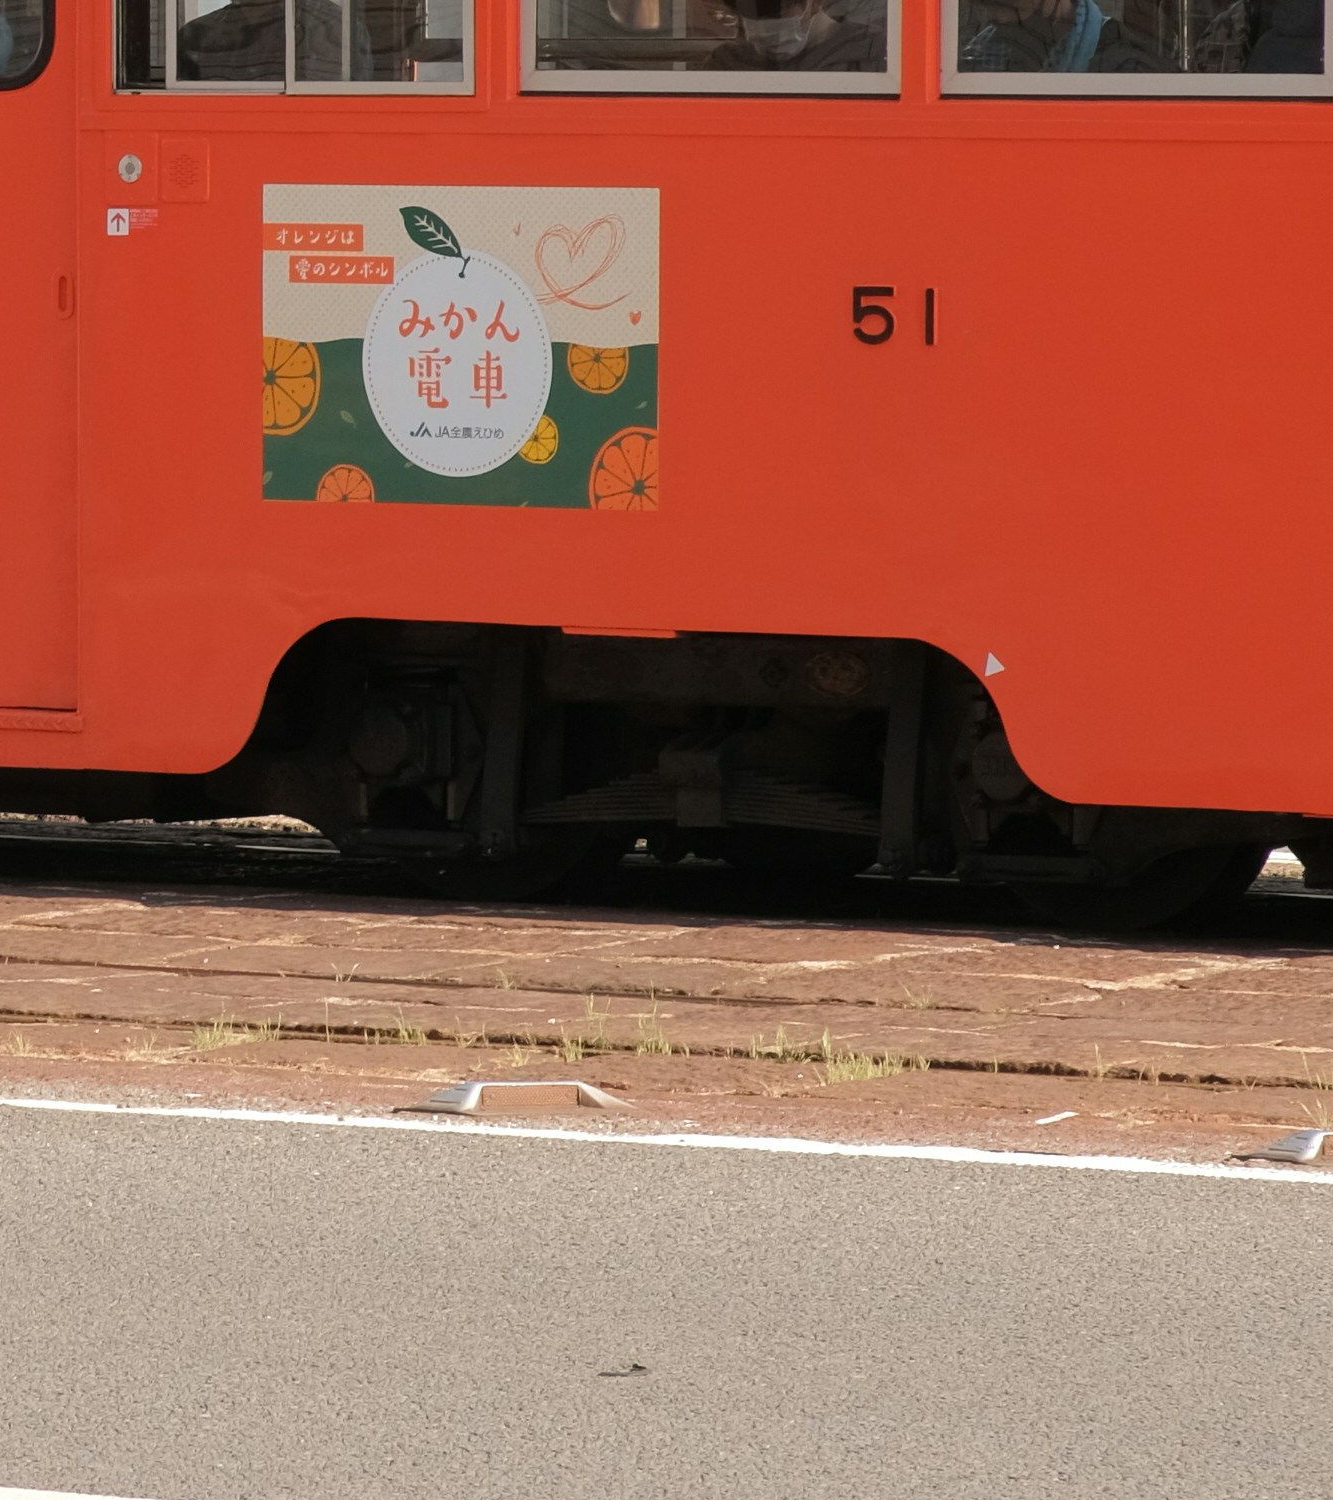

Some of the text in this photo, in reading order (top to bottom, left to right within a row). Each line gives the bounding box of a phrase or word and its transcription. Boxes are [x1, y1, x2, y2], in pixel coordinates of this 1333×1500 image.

[276, 228, 355, 245] オレンジは
[295, 259, 388, 280] 愛のシンボル
[398, 299, 520, 342] みかん
[853, 286, 935, 346] 51
[408, 347, 507, 409] 電車
[434, 425, 505, 440] JA全農えひめ
